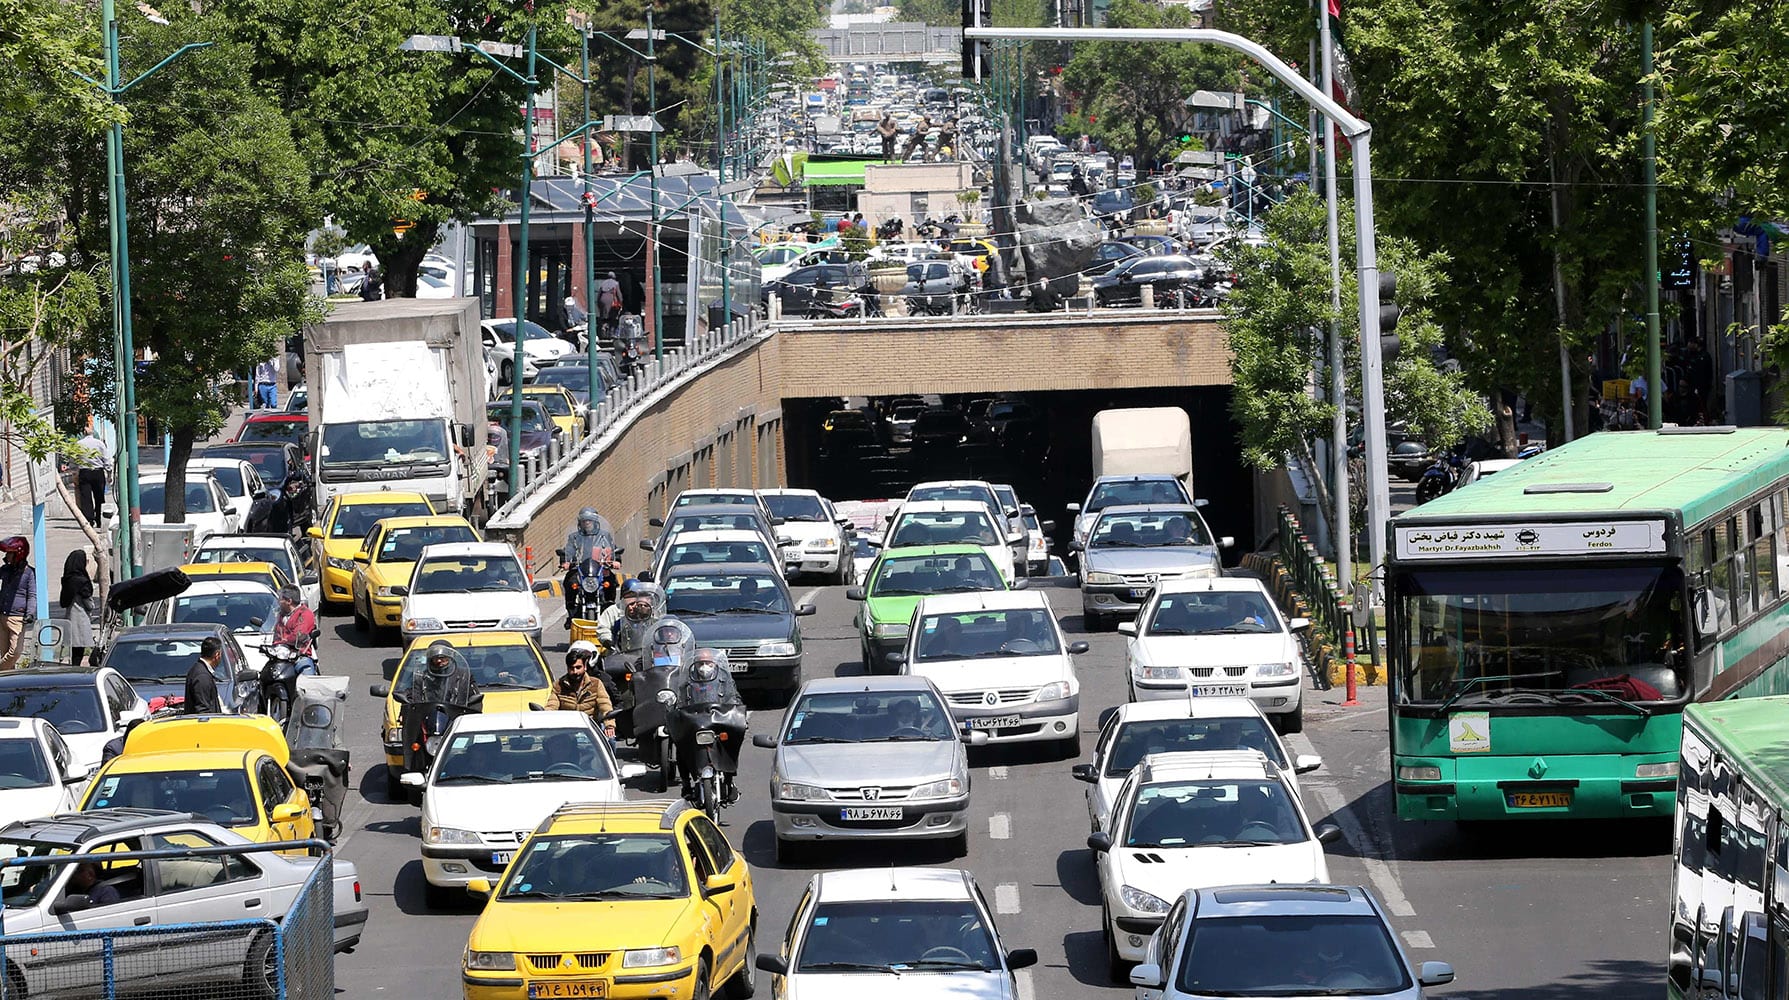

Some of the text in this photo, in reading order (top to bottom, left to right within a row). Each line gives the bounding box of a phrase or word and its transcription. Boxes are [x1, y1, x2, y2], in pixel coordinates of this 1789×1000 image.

[363, 470, 408, 481] KAVIAN
[1408, 529, 1505, 544] شهید دکتر فیاض بخش
[1582, 524, 1617, 538] فردوس
[1418, 543, 1502, 553] Martyr Dr.Fayazbakhsh
